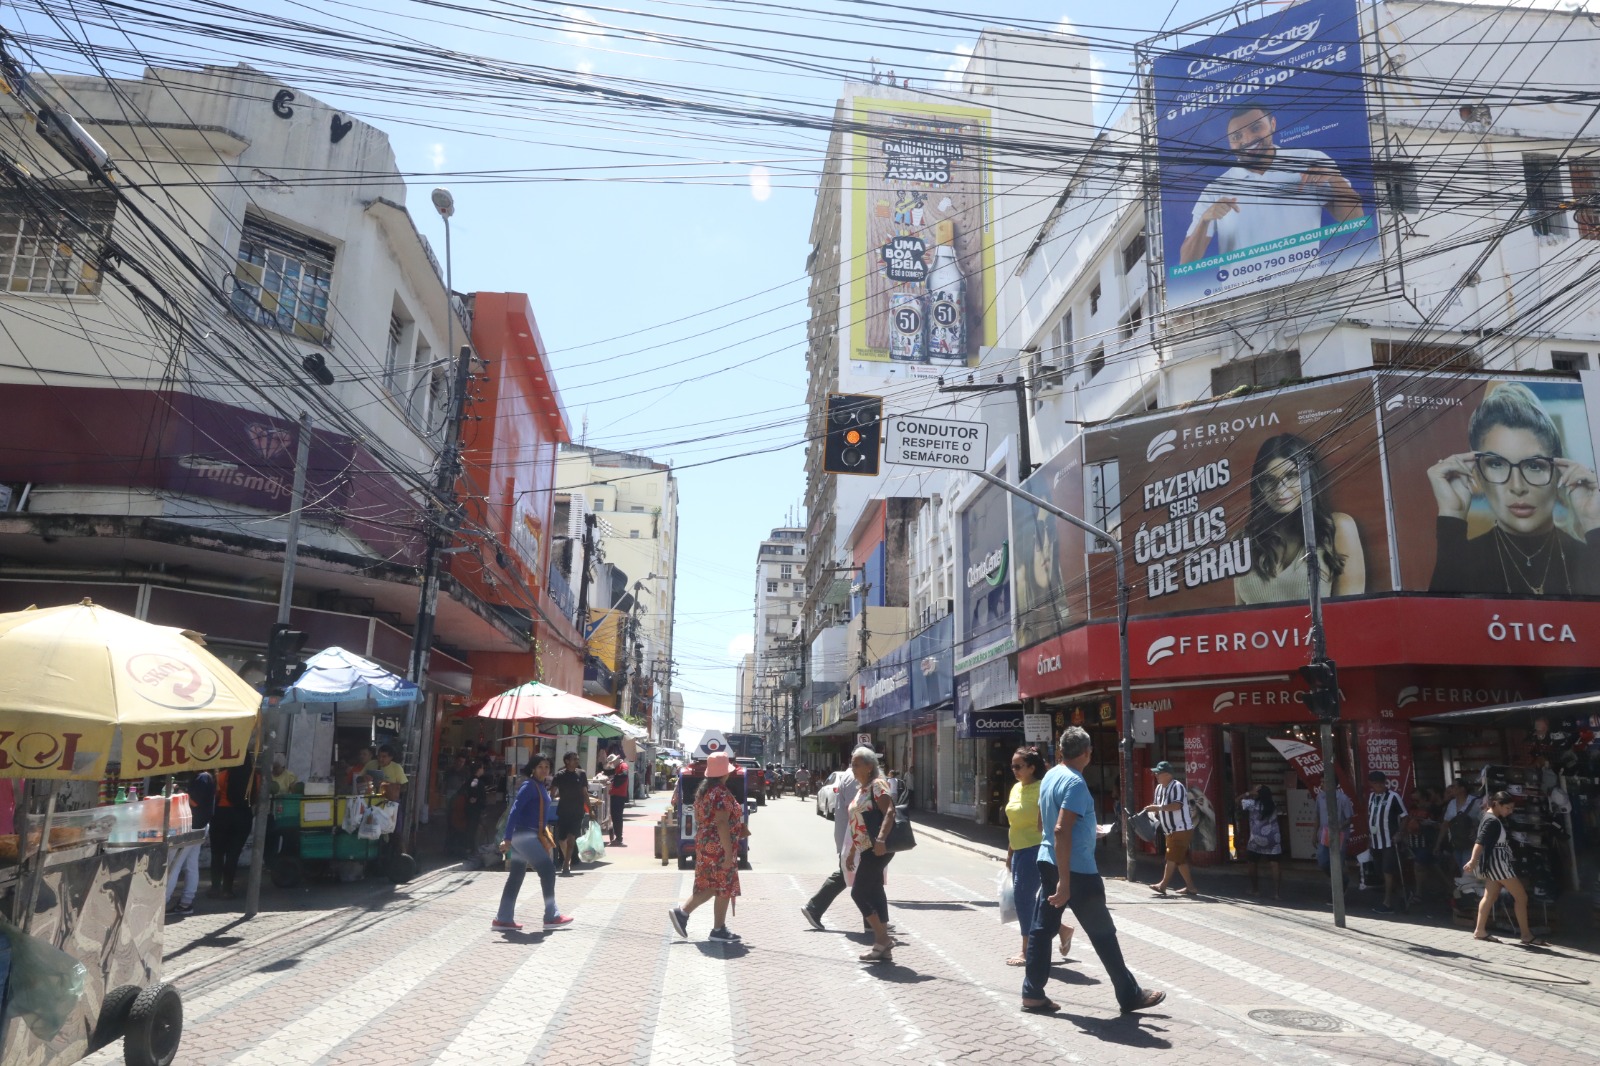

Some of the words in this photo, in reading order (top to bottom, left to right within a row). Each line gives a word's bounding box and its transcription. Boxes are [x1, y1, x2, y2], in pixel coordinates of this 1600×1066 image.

[1288, 48, 1316, 66] quem
[1317, 42, 1333, 54] faz
[1166, 109, 1177, 120] o
[1181, 75, 1260, 116] MELHOR
[1264, 69, 1296, 91] por
[1300, 45, 1347, 74] você
[888, 166, 948, 182] ASSADO
[885, 248, 914, 260] BOA
[894, 240, 924, 252] UMA
[1173, 264, 1194, 276] FAÇA
[1195, 256, 1224, 270] AGORA
[1226, 251, 1246, 264] UMA
[1248, 237, 1296, 259] AVALIAÇÃO
[1299, 230, 1322, 243] AQUI
[1324, 219, 1367, 237] EMBAIXO
[891, 258, 924, 271] IDEIA
[1232, 262, 1263, 278] 0800
[1263, 256, 1287, 271] 790
[1288, 247, 1320, 264] 8080
[900, 312, 915, 331] 51
[938, 306, 953, 322] 51
[1407, 395, 1463, 407] FERROVIA
[896, 420, 979, 440] CONDUTOR
[1183, 411, 1280, 441] FERROVIA
[902, 437, 959, 451] RESPEITE
[962, 441, 972, 452] O
[1183, 435, 1236, 450] EYEWEAR
[902, 450, 969, 465] SEMÁFORO
[1143, 458, 1231, 512] FAZEMOS
[1169, 497, 1199, 520] SEUS
[1134, 506, 1227, 564] ÓCULOS
[1147, 559, 1179, 599] DE
[1184, 537, 1252, 588] GRAU
[1488, 614, 1577, 643] ÓTICA
[141, 661, 186, 687] SKOL
[1037, 655, 1062, 676] ÓTICA
[1238, 688, 1346, 706] FERRO
[1421, 687, 1524, 703] FERROVIA
[1380, 709, 1394, 719] 136
[136, 725, 241, 772] SKOL
[1366, 738, 1398, 746] COMPRE
[1294, 753, 1321, 767] Faça
[1368, 754, 1399, 762] GANHE
[1368, 761, 1400, 769] OUTRO
